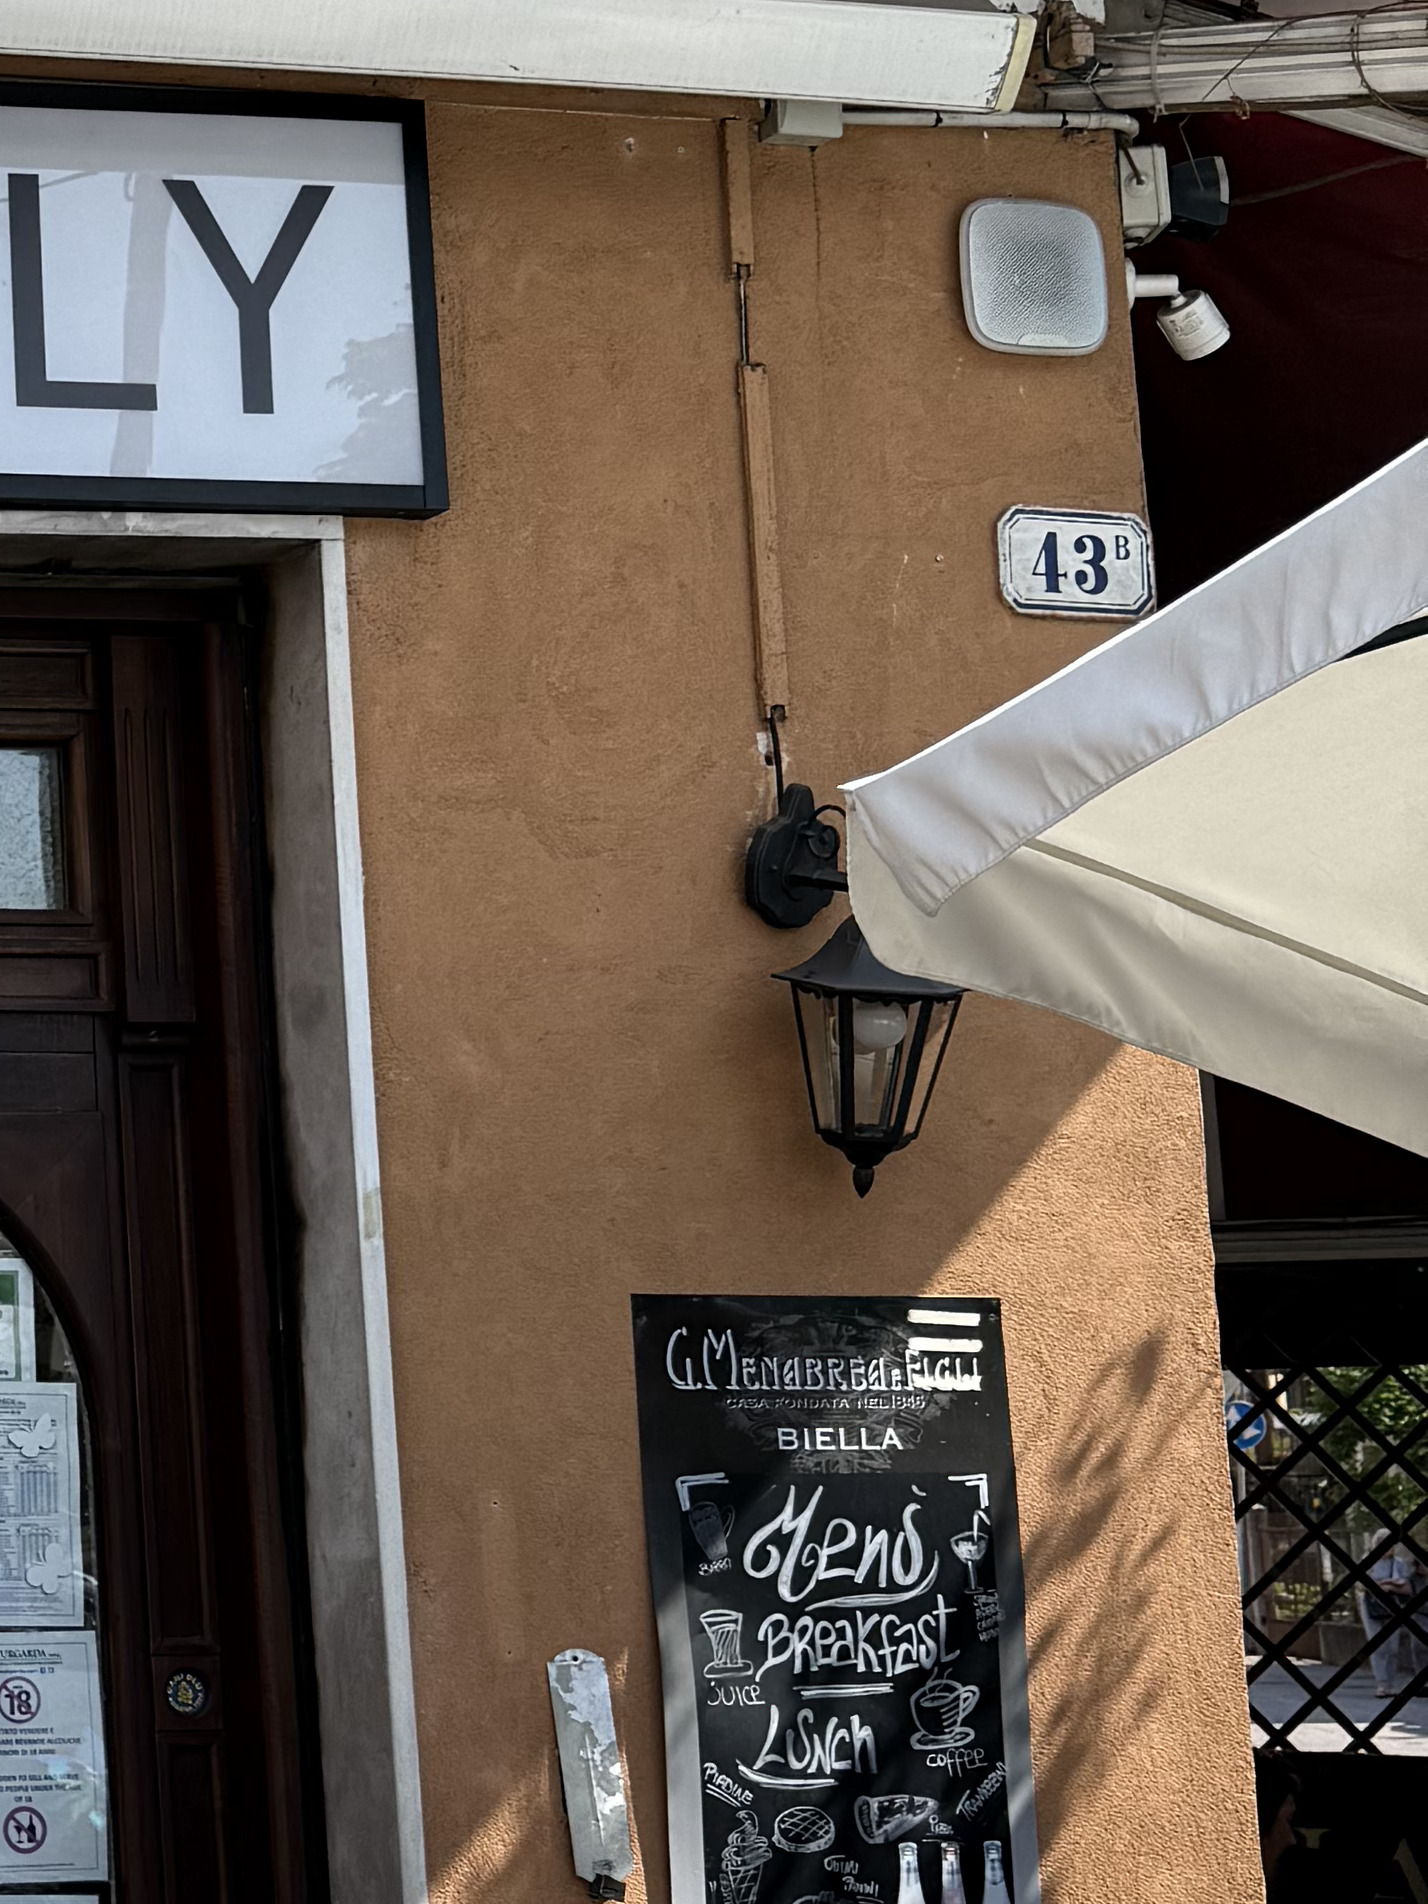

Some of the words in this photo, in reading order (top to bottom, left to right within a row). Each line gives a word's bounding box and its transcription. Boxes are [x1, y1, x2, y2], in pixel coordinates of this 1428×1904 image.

[726, 1398, 769, 1410] CASA
[774, 1397, 850, 1410] FONDATA
[858, 1397, 889, 1410] NEL
[776, 1427, 904, 1451] BIELLA
[4, 1690, 32, 1716] 18
